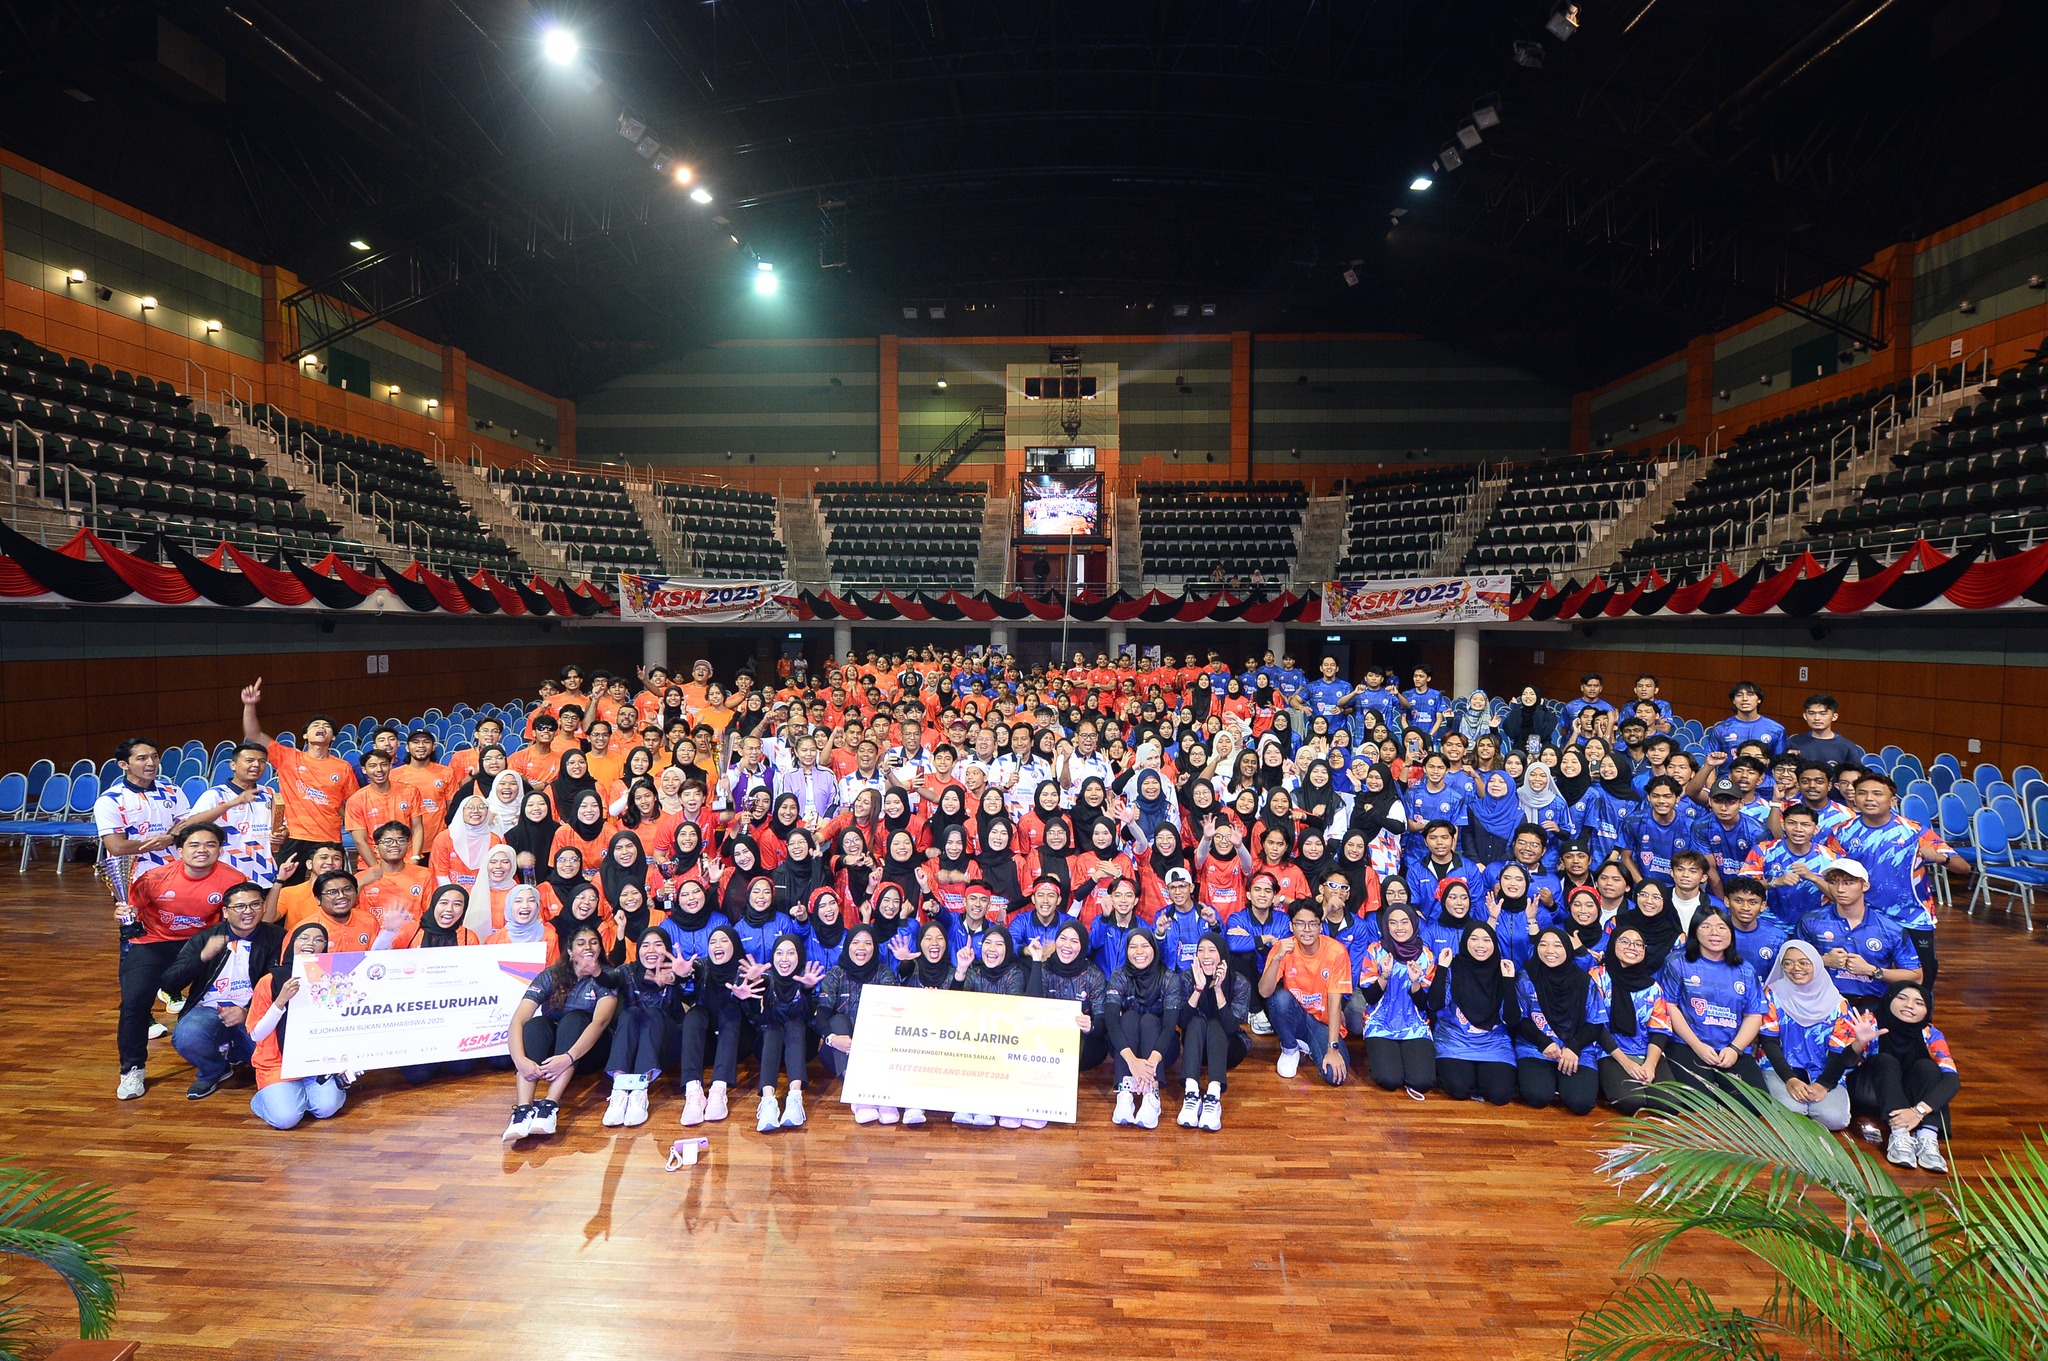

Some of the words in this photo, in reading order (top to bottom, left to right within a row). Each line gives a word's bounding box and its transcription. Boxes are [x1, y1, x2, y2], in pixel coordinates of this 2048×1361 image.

[652, 590, 702, 608] KSM
[705, 585, 759, 604] 2025
[1348, 591, 1398, 612] KSM
[1399, 581, 1463, 605] 2025
[341, 1004, 393, 1017] JUARA
[396, 995, 498, 1013] KESELURUHAN
[1707, 1005, 1730, 1013] TENAGA
[310, 1025, 355, 1035] KEJOHANAN
[357, 1023, 381, 1031] SUKAN
[383, 1019, 426, 1028] MAHASISWA
[428, 1017, 444, 1025] 2025
[458, 1033, 490, 1048] KSM
[894, 1026, 928, 1037] EMAS
[939, 1029, 971, 1041] BOLA
[973, 1032, 1019, 1045] JARING
[973, 1053, 996, 1061] SAHAJA
[1008, 1053, 1021, 1061] RM
[889, 1063, 912, 1072] ATLET
[913, 1065, 960, 1075] CEMERLANG
[961, 1069, 989, 1078] SUKIPT
[990, 1072, 1010, 1080] 2024
